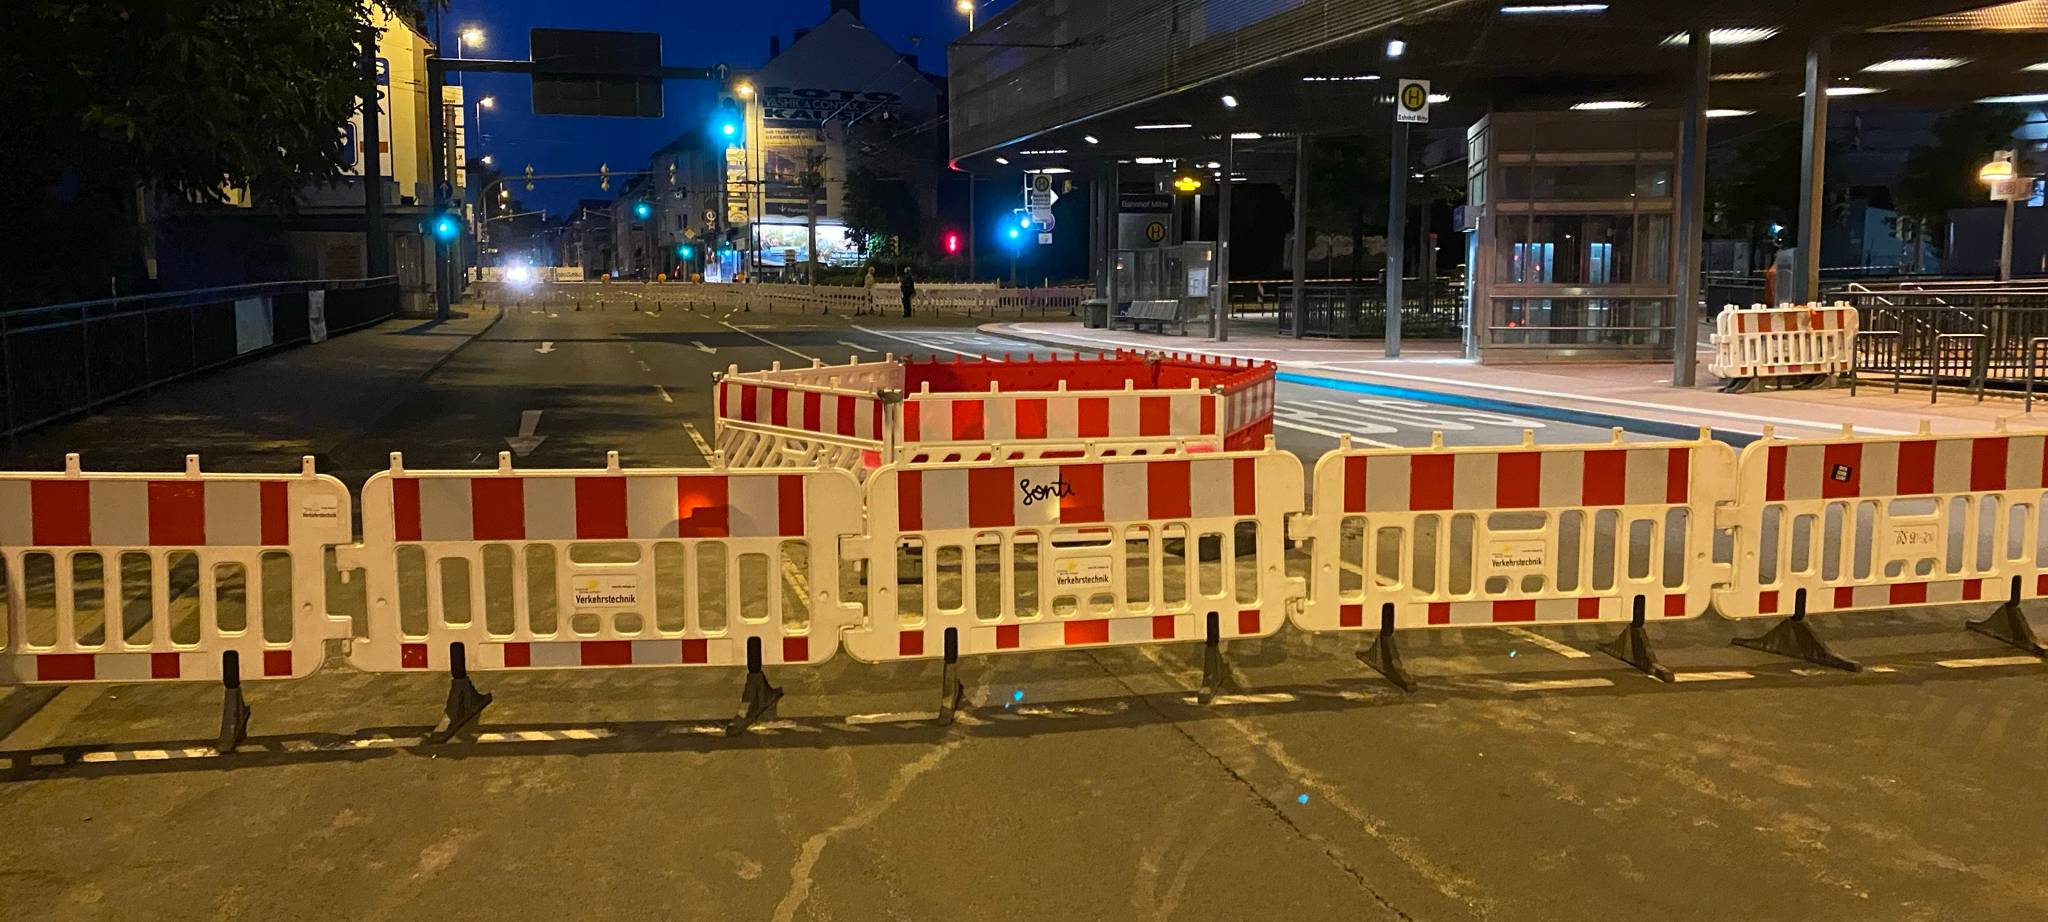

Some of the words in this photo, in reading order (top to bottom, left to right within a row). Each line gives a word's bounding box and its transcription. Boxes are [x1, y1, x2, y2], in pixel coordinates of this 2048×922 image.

[764, 87, 901, 101] FOTO
[1491, 557, 1542, 568] Verkehrstechnik
[1056, 574, 1110, 586] Verkehrstechnik
[575, 594, 636, 604] Verkehrstechnik
